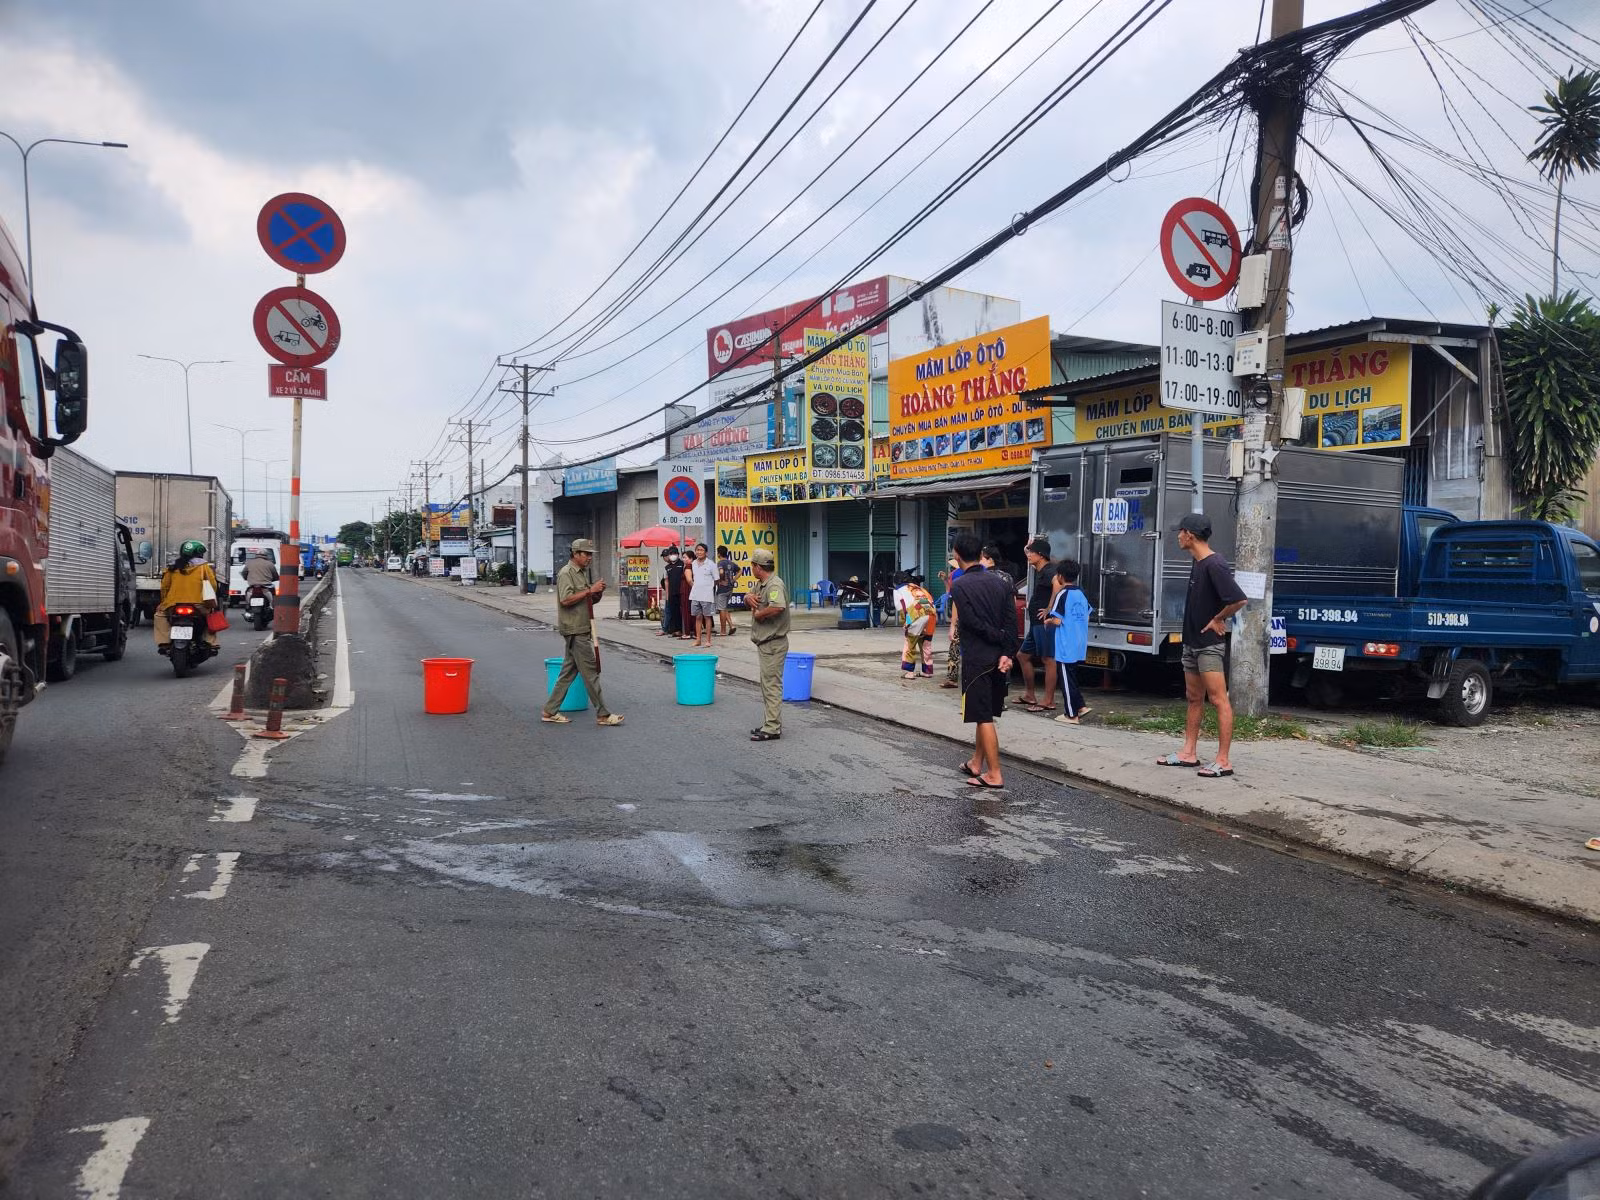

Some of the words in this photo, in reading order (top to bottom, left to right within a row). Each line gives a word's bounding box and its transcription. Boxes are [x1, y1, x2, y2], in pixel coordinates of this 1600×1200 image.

[1172, 311, 1234, 338] 6:00-8:00
[916, 357, 944, 381] MÂM
[948, 345, 972, 372] LỐP
[977, 336, 1006, 364] ÔTÔ
[1166, 345, 1234, 373] 11:00-13:0
[1291, 347, 1389, 387] THẮNG
[285, 368, 311, 384] CẤM
[275, 386, 284, 394] XE
[900, 383, 956, 417] HOÀNG
[961, 362, 1028, 404] THẮNG
[1165, 381, 1241, 408] 17:00-19:00
[1309, 391, 1330, 410] DU
[1336, 386, 1372, 409] LỊCH
[1086, 399, 1119, 421] MÂM
[1124, 388, 1153, 414] LỐP
[892, 422, 916, 437] CHUYÊN
[918, 420, 932, 431] MUA
[935, 414, 948, 428] BÁN
[951, 411, 968, 425] MÂM
[970, 405, 985, 422] LỐP
[988, 402, 1004, 419] ÔTÔ
[1012, 401, 1023, 414] DU
[1096, 420, 1137, 439] CHUYÊN
[1140, 417, 1165, 433] MUA
[1168, 409, 1193, 429] BÁN
[672, 464, 693, 473] ZONE
[754, 460, 772, 472] MÂM
[775, 456, 791, 470] LỐP
[825, 469, 865, 479] 0986.514458
[784, 473, 797, 481] MUA
[1116, 489, 1149, 497] FRONTIER
[717, 503, 748, 523] HOÀNG
[721, 526, 746, 545] VÁ
[752, 524, 775, 545] VỎ
[1298, 608, 1358, 622] 51D-398.94
[1427, 613, 1469, 626] 51D-398.94
[1321, 648, 1337, 658] 51D
[1314, 658, 1341, 669] 398.94
